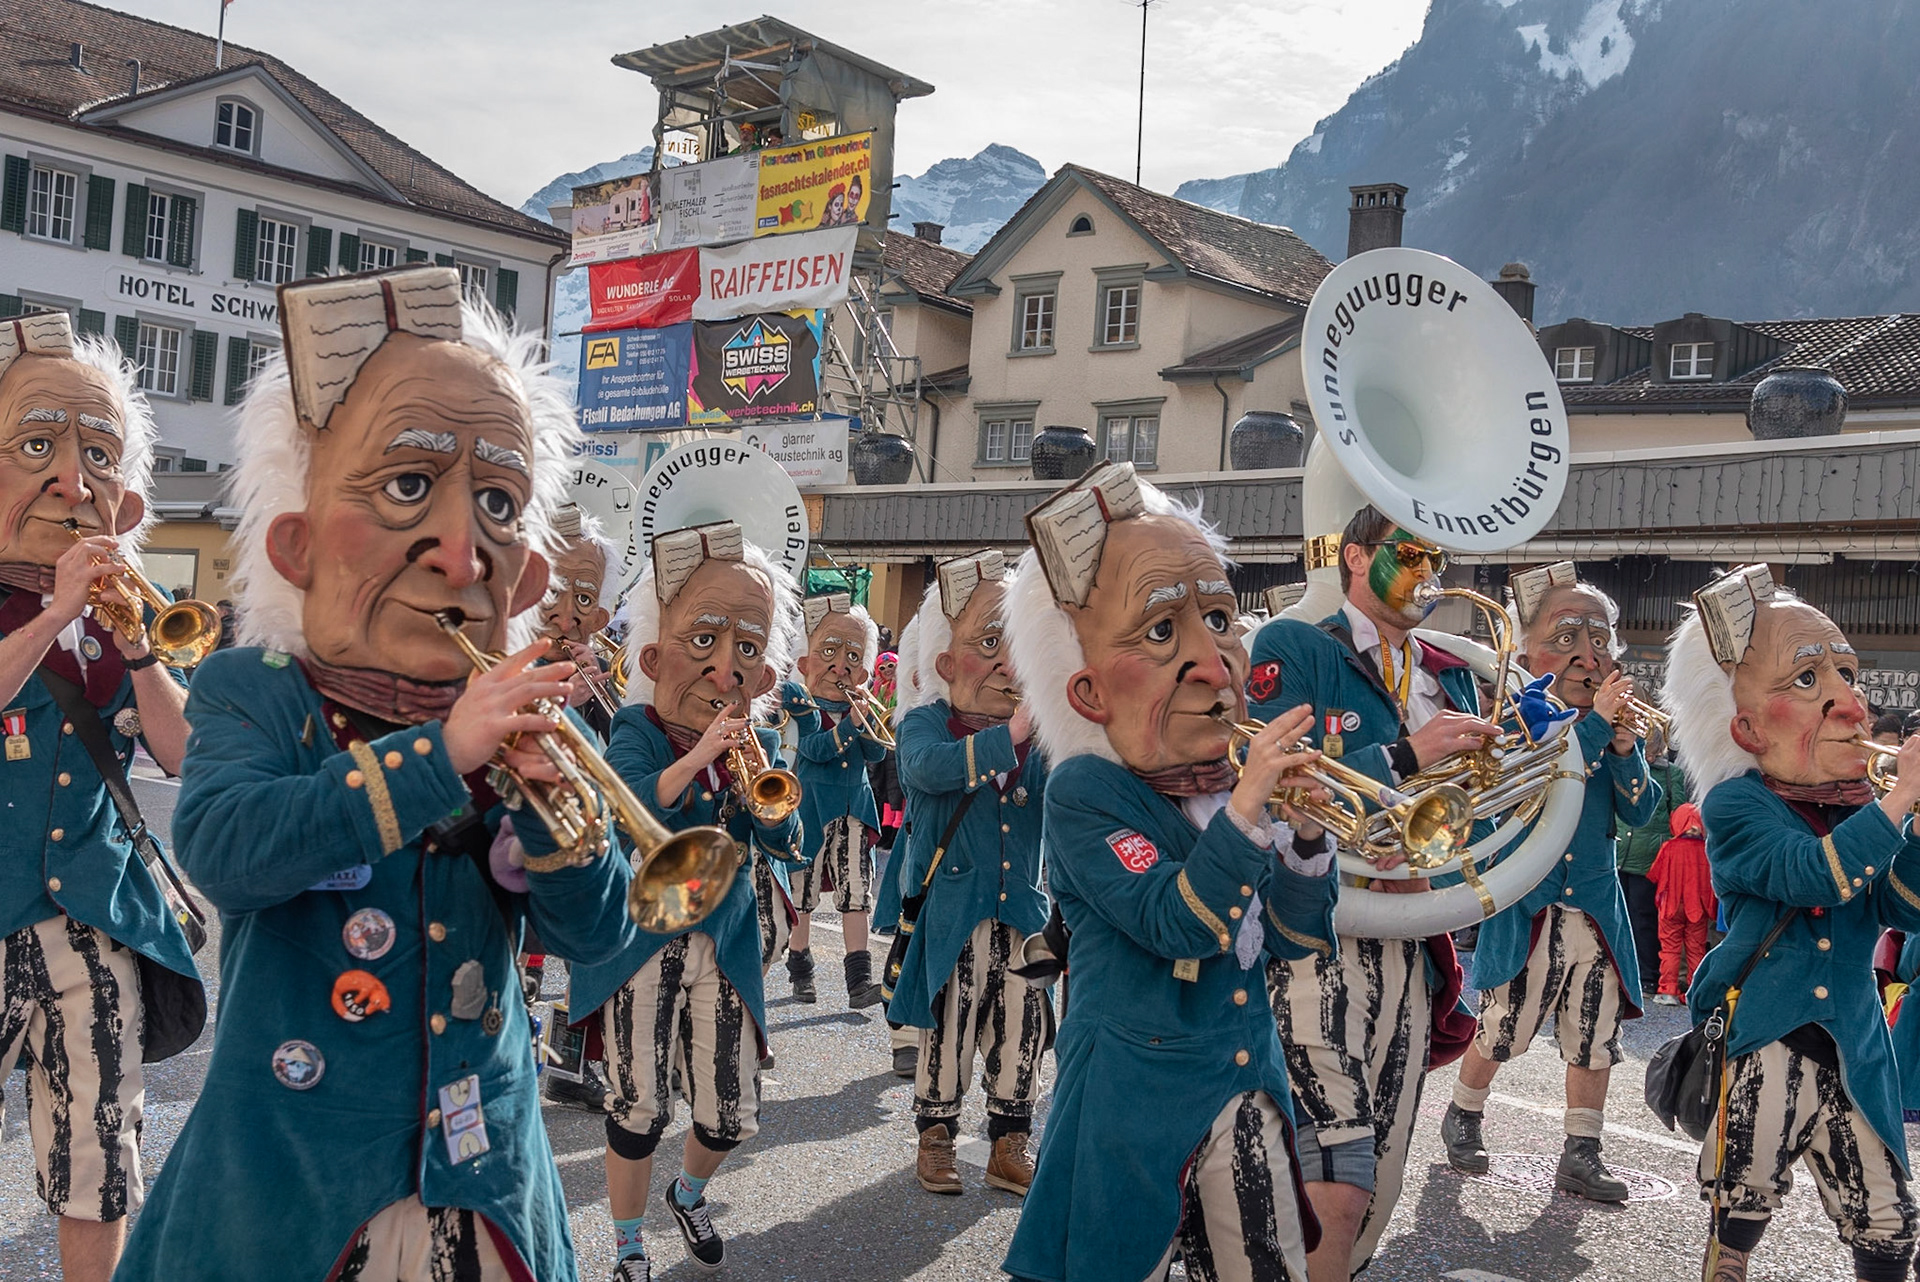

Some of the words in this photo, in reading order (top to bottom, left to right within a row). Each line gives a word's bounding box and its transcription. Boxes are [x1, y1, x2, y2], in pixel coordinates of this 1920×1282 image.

[760, 154, 870, 201] fasnachtskalender.ch
[710, 252, 844, 300] RAIFFEISEN
[119, 274, 195, 307] HOTEL
[607, 279, 660, 299] WUNDERLE
[661, 276, 674, 290] AG
[668, 294, 692, 302] SOLAR
[588, 341, 617, 365] FA
[726, 345, 788, 368] SWISS
[1322, 271, 1468, 446] Sunneguugger
[601, 375, 610, 384] Ihr
[610, 372, 656, 385] Ansprechpartner
[656, 369, 665, 380] für
[725, 363, 787, 377] WERBETECHNIK
[604, 388, 630, 400] gesamte
[631, 384, 669, 397] Gebäudehülle
[610, 404, 667, 422] Bedachungen
[667, 401, 680, 419] AG
[572, 440, 618, 457] Stüssi
[782, 433, 815, 449] glarner
[828, 449, 843, 463] ag
[1411, 390, 1561, 536] Ennetbürgen
[1857, 670, 1919, 687] ISTRO
[1869, 688, 1917, 708] BAR
